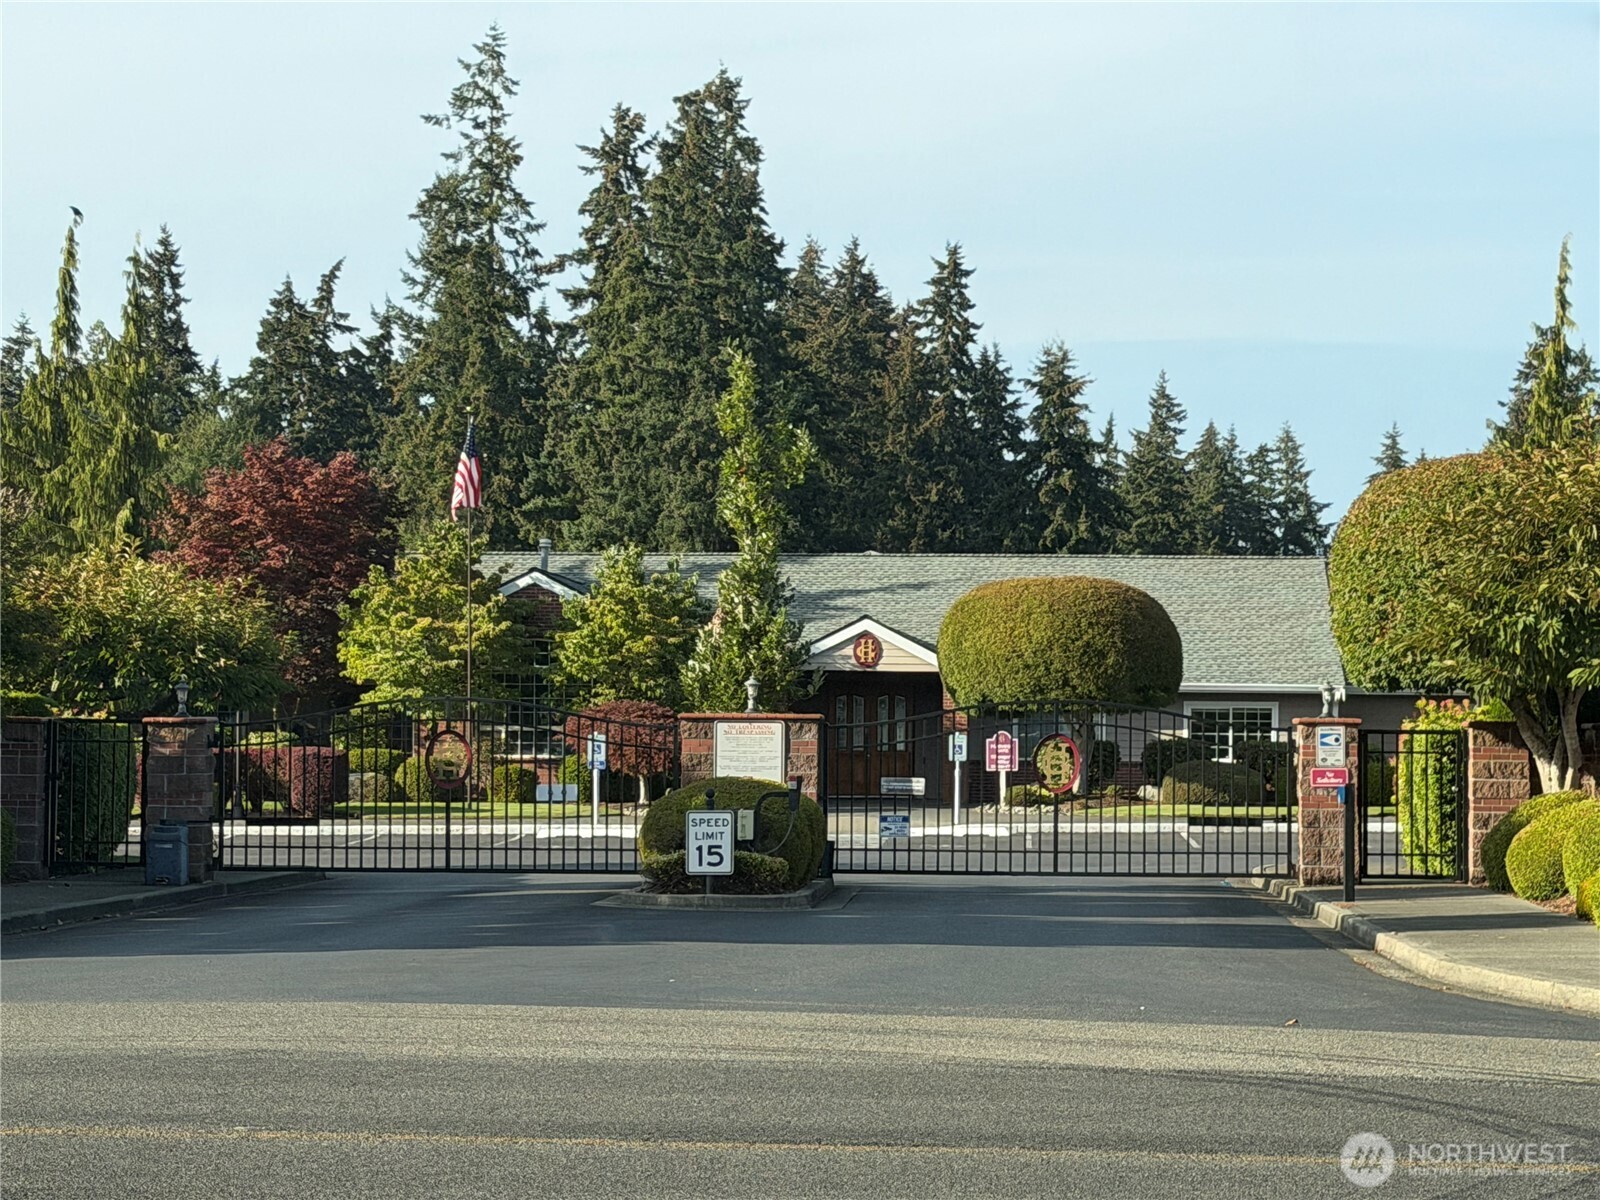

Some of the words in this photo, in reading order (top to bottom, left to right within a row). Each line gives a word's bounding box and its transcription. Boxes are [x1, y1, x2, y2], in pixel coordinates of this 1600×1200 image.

[691, 818, 730, 827] SPEED
[695, 831, 725, 840] LIMIT
[696, 845, 724, 867] 15
